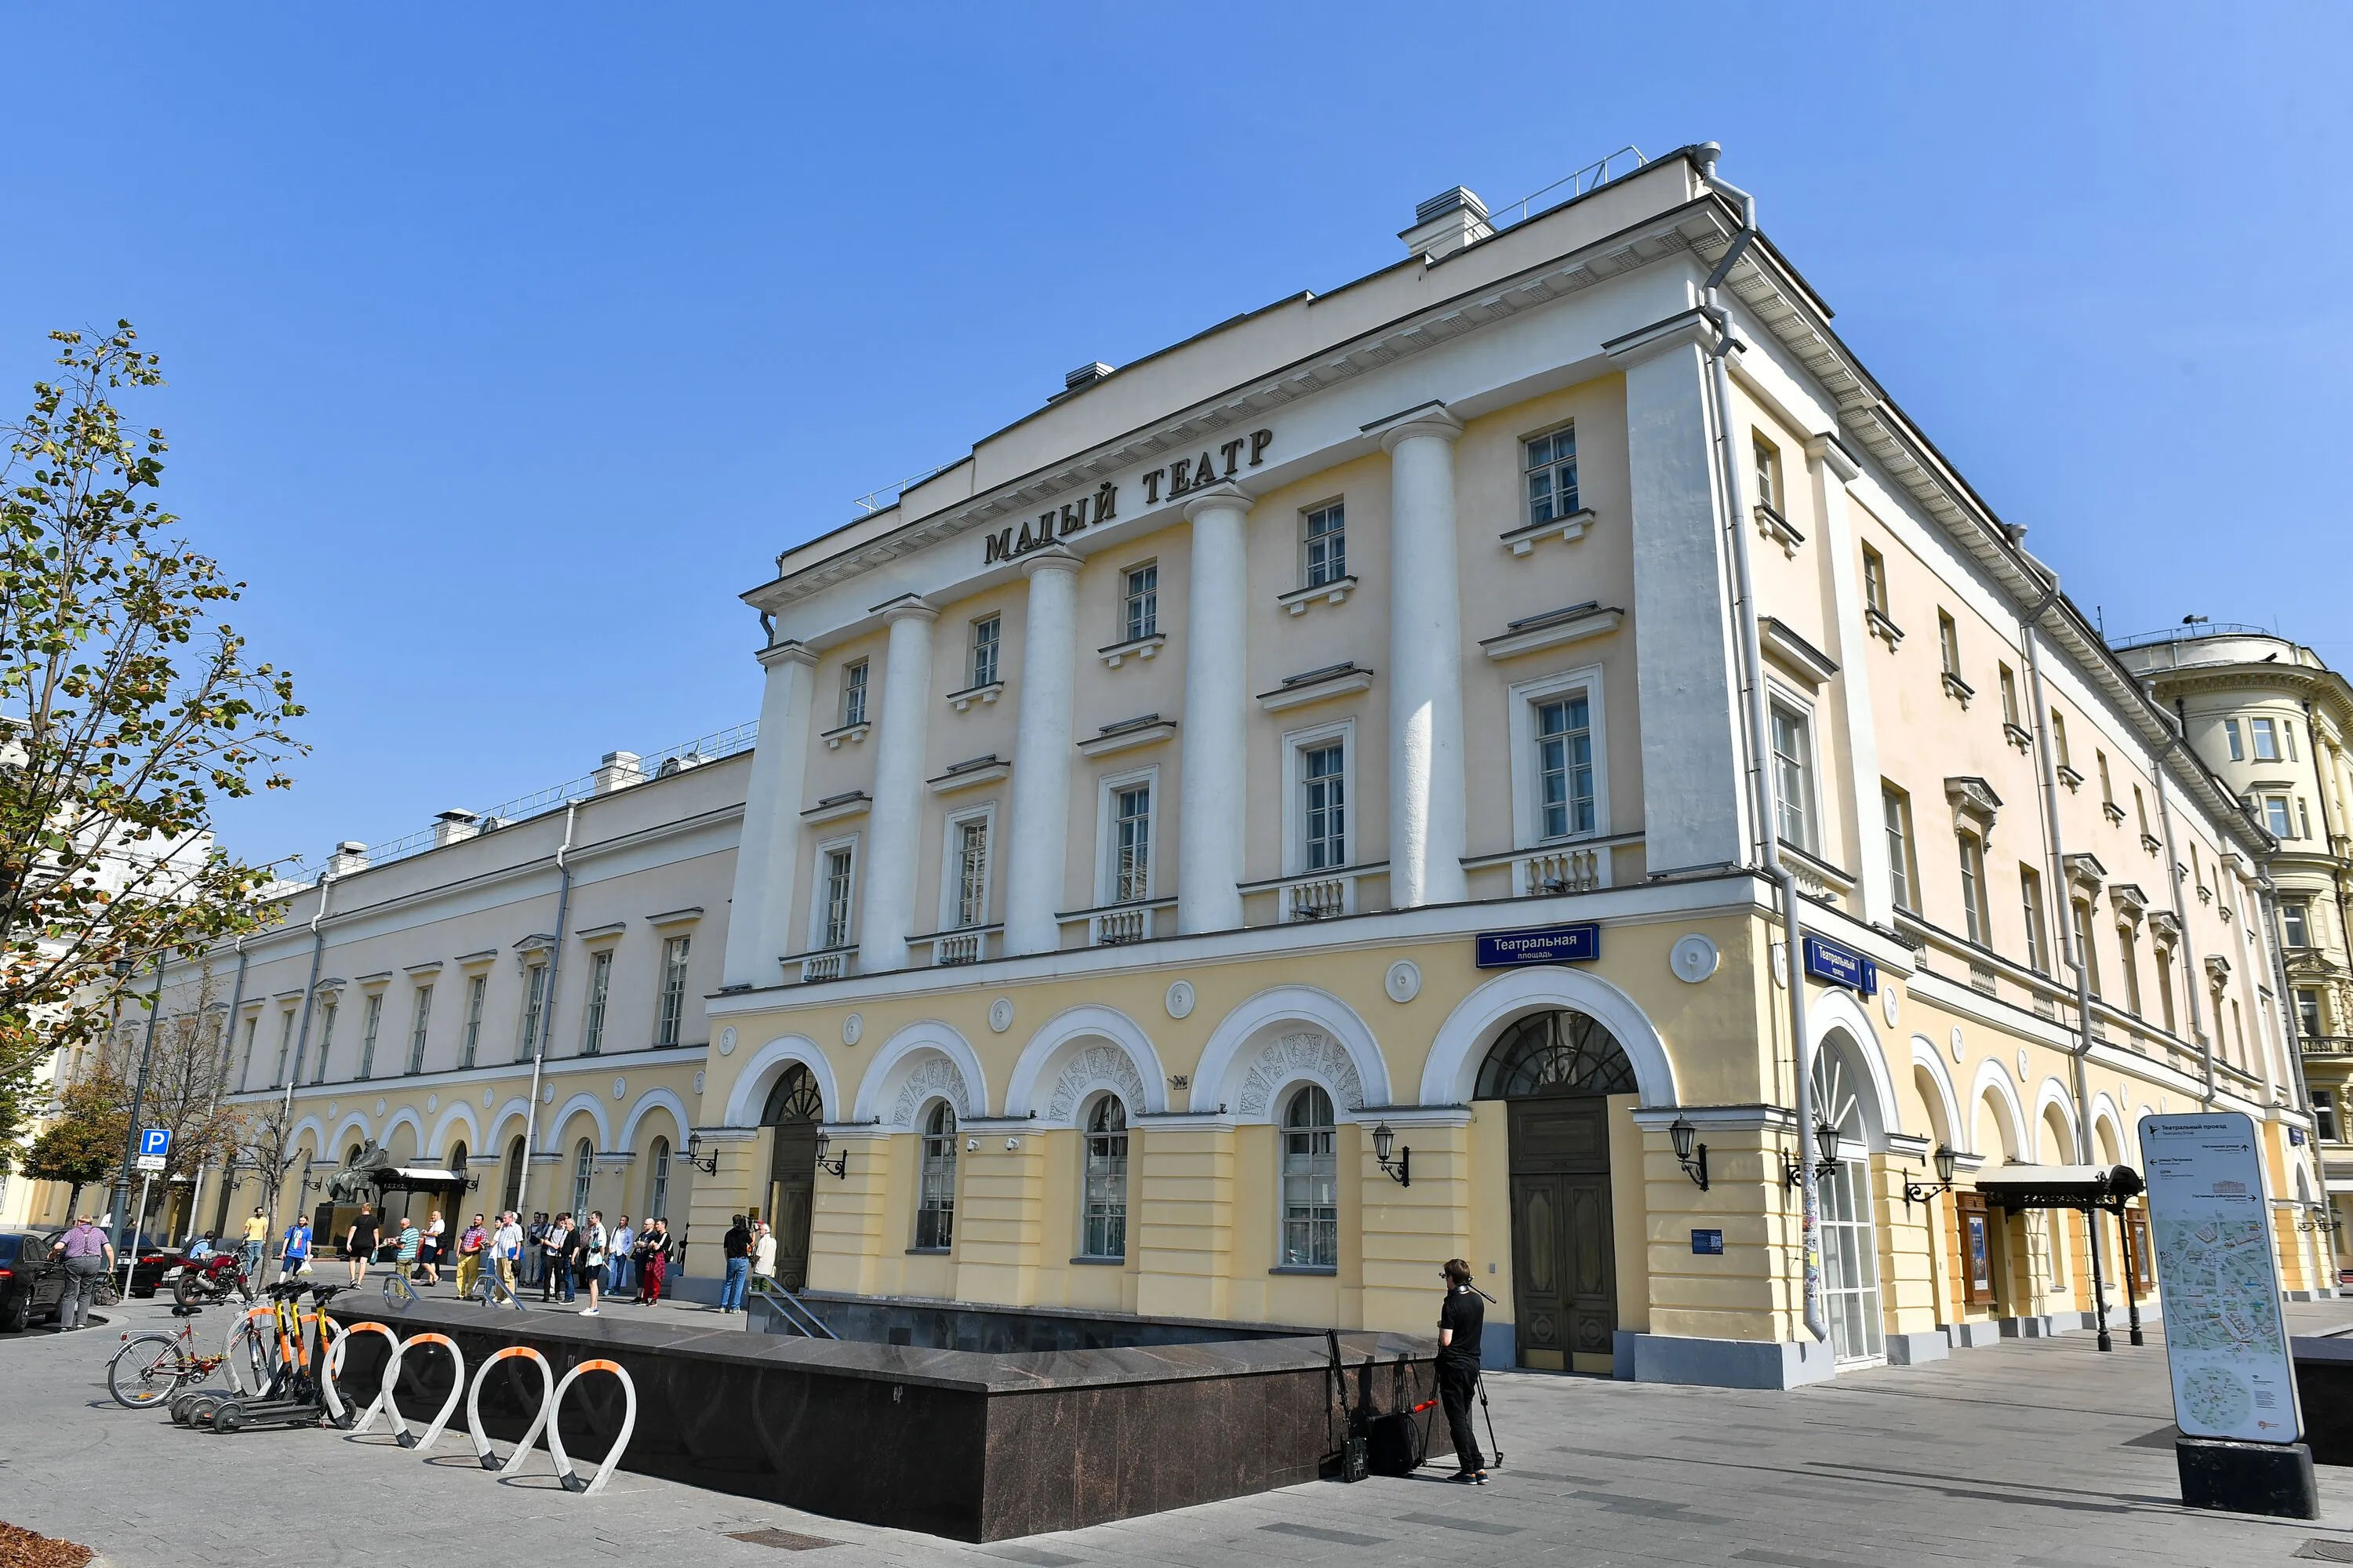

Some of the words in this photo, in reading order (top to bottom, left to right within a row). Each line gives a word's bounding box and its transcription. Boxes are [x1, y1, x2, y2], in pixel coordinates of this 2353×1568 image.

[984, 481, 1118, 565] МАЛЫЙ
[1142, 428, 1273, 504] ТЕАТР
[1494, 936, 1577, 951] Театральная
[1818, 946, 1855, 970] Театральный
[1868, 968, 1873, 988] 1
[147, 1132, 165, 1152] P
